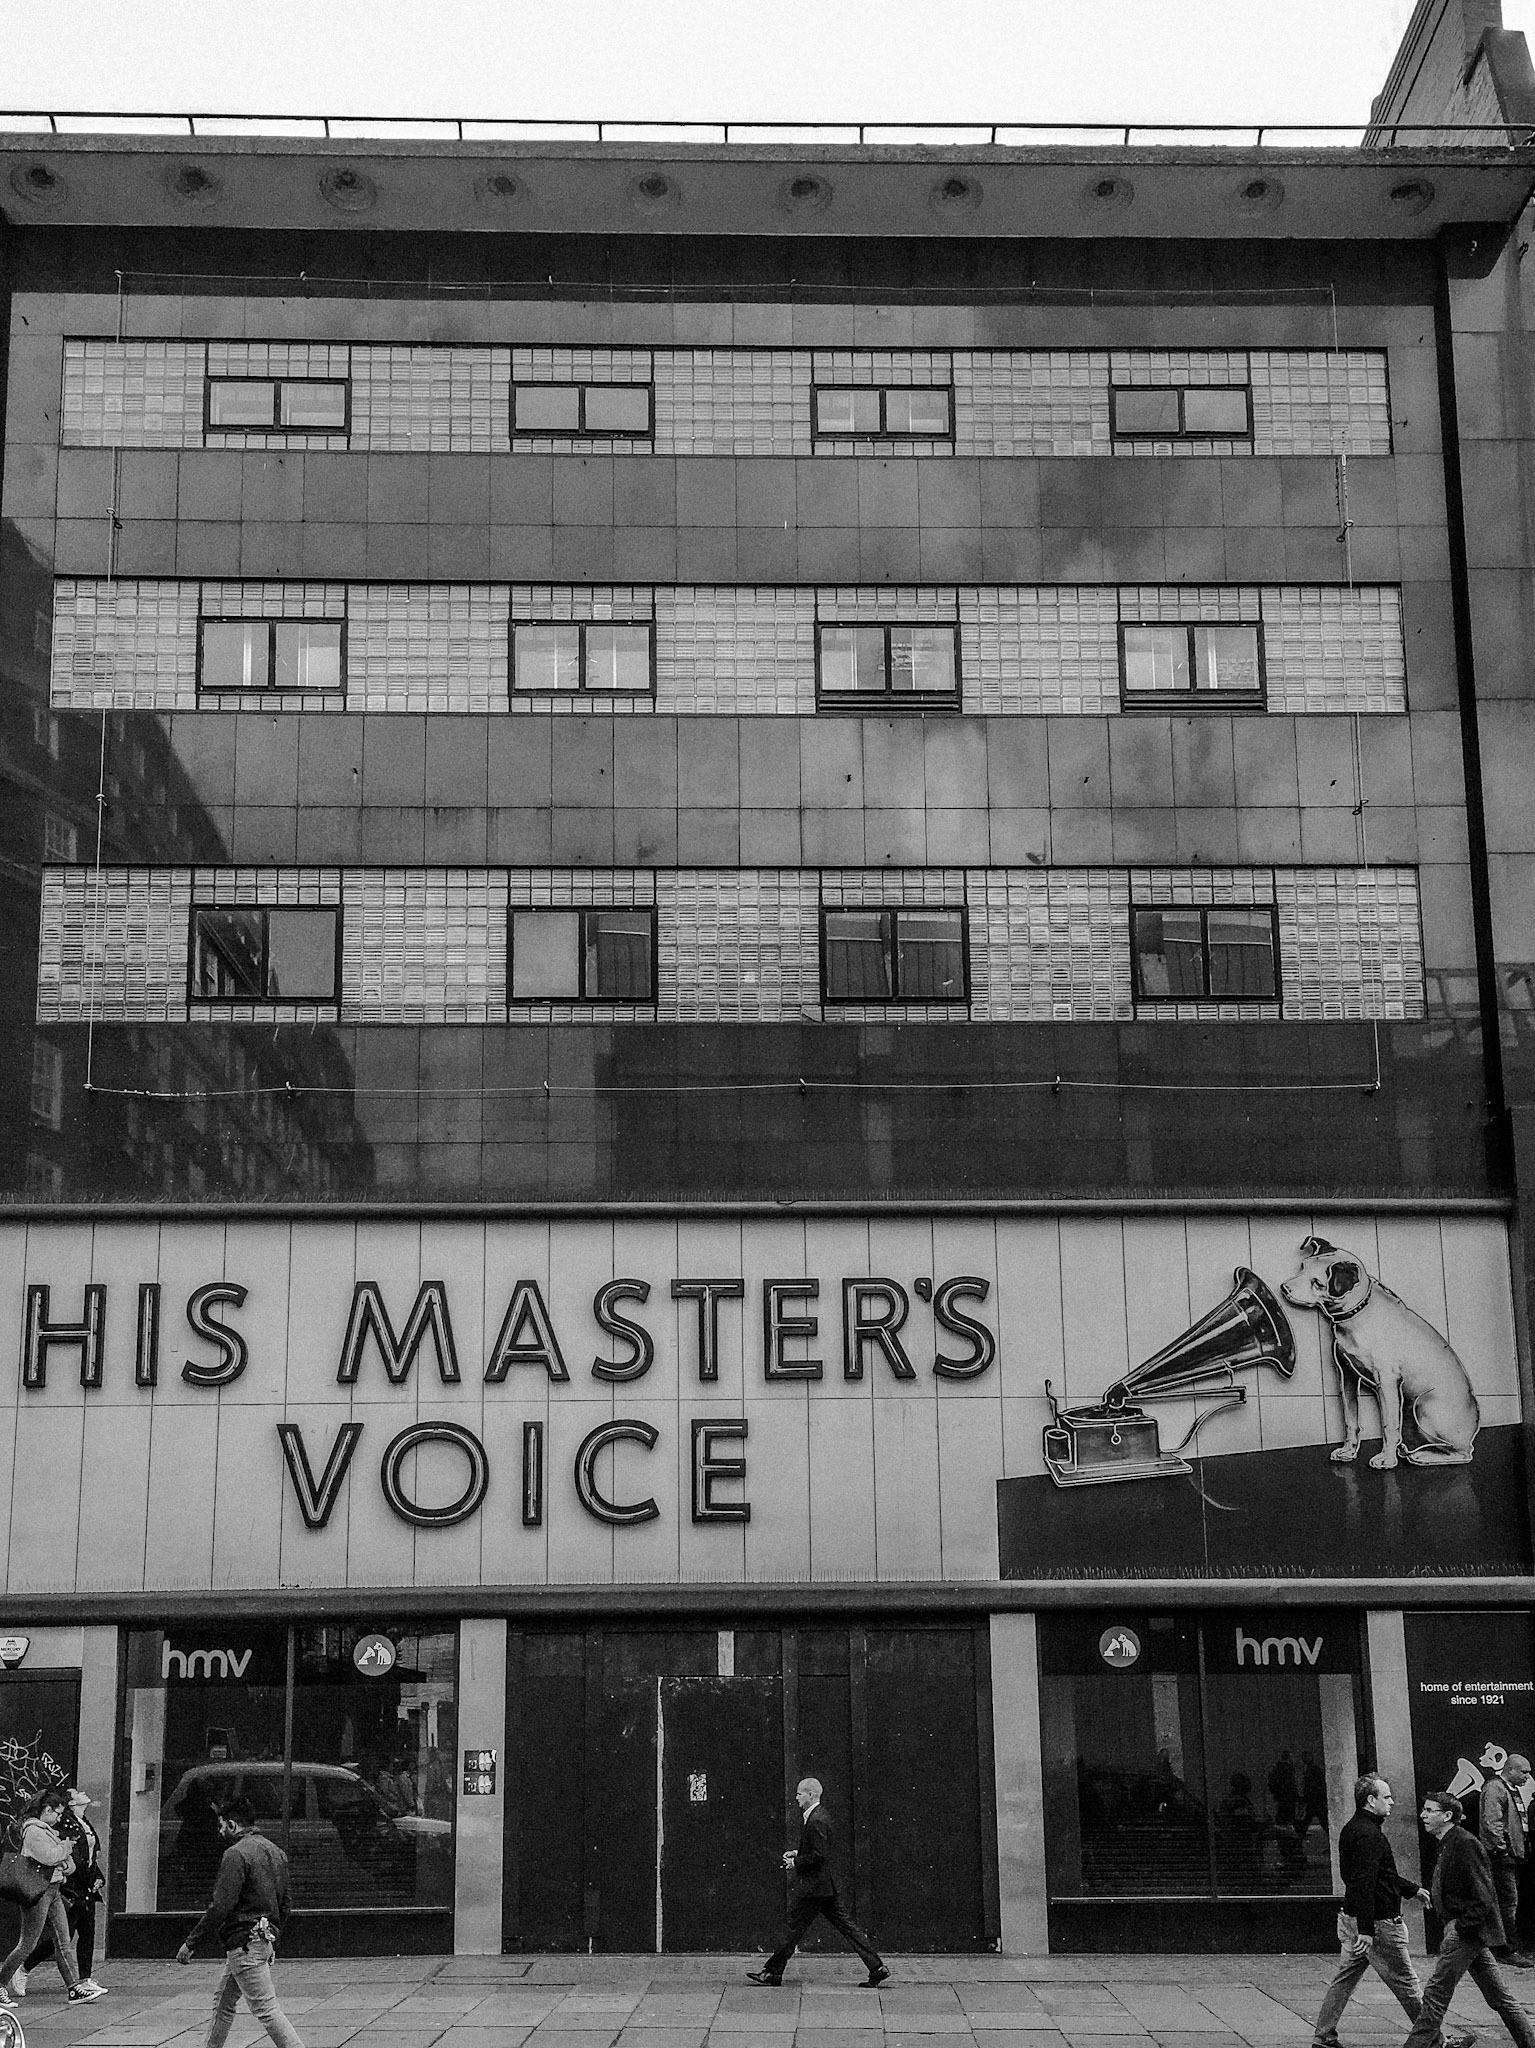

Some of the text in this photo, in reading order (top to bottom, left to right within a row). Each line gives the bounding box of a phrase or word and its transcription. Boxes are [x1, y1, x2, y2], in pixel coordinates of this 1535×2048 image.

[23, 1276, 996, 1388] HIS MASTER'S
[276, 1419, 751, 1528] VOICE
[161, 1640, 253, 1679] hmv
[1235, 1627, 1323, 1665] hmv
[1420, 1681, 1534, 1692] home of entertainment
[1450, 1694, 1505, 1705] since 1921
